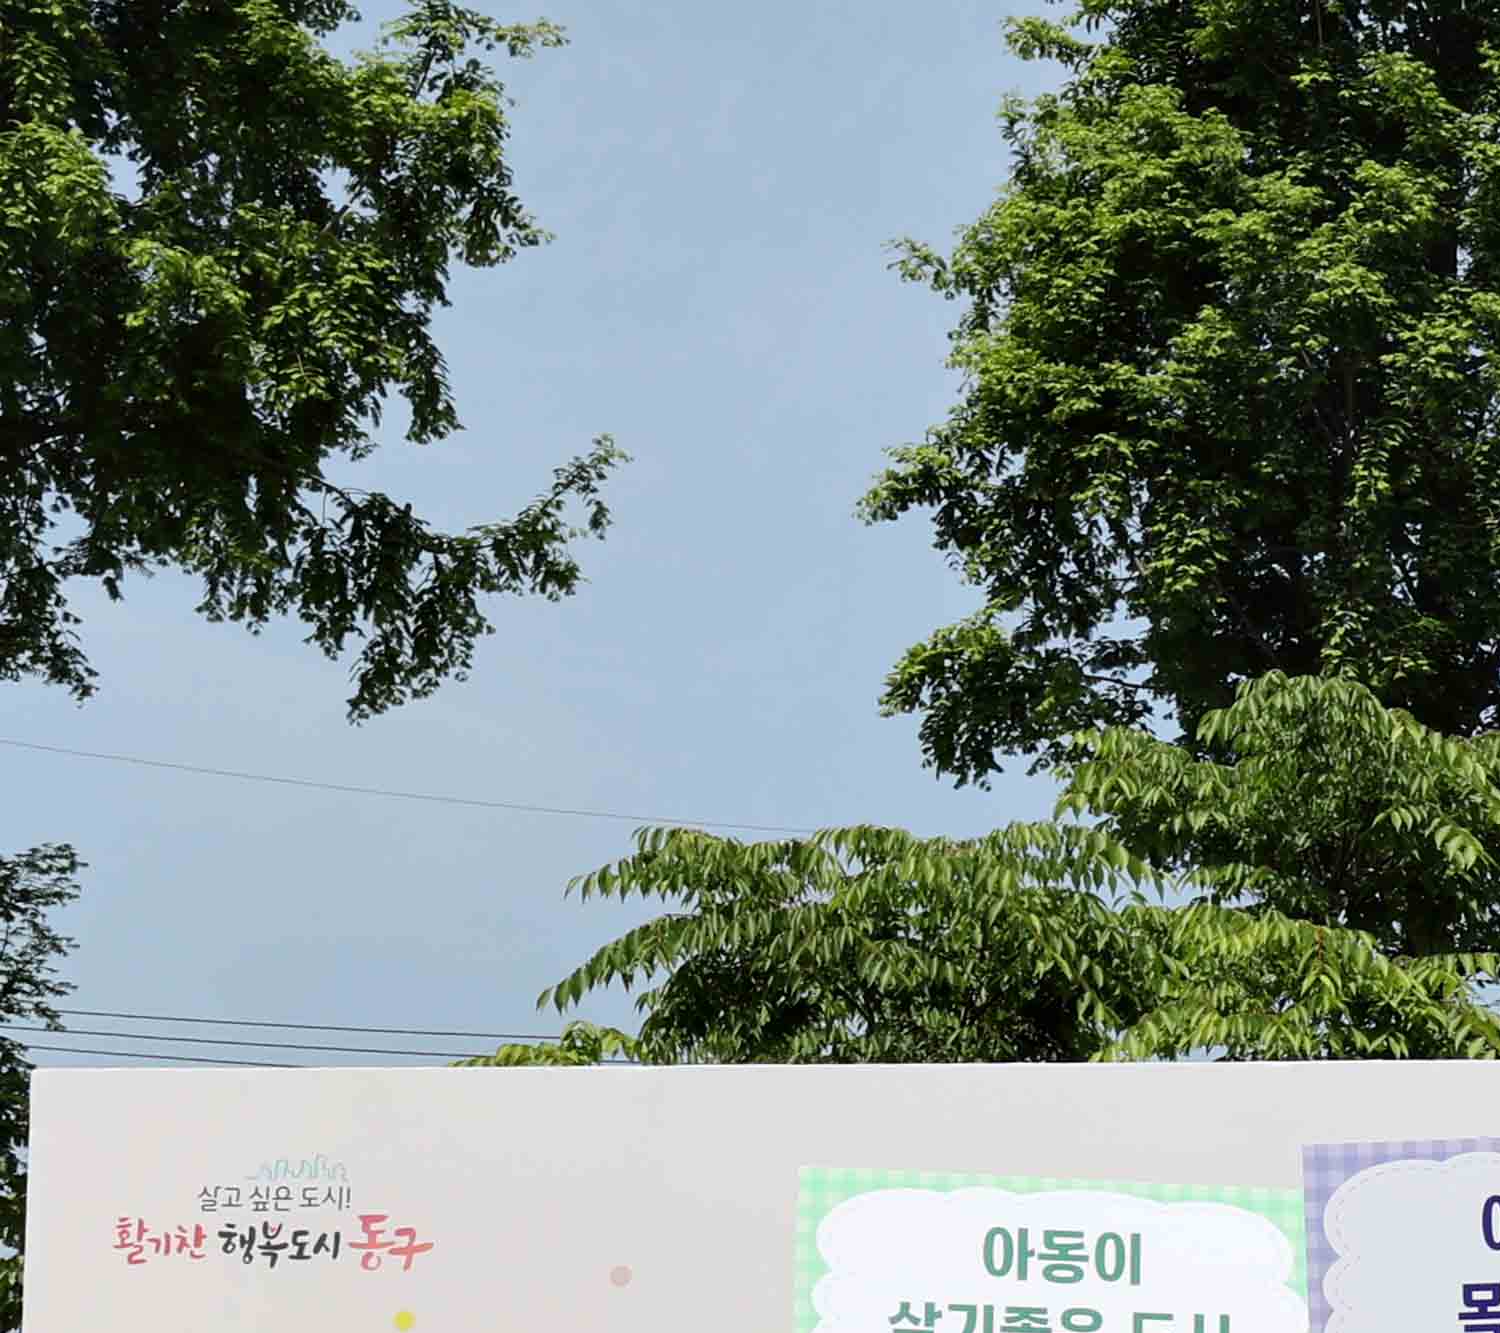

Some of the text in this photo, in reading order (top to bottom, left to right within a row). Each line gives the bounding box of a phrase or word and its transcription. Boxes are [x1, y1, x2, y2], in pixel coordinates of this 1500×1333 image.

[198, 1184, 352, 1212] 살고 싶은 도시!
[112, 1213, 434, 1272] 활기찬 행복도시 동구
[984, 1227, 1140, 1285] 아동이
